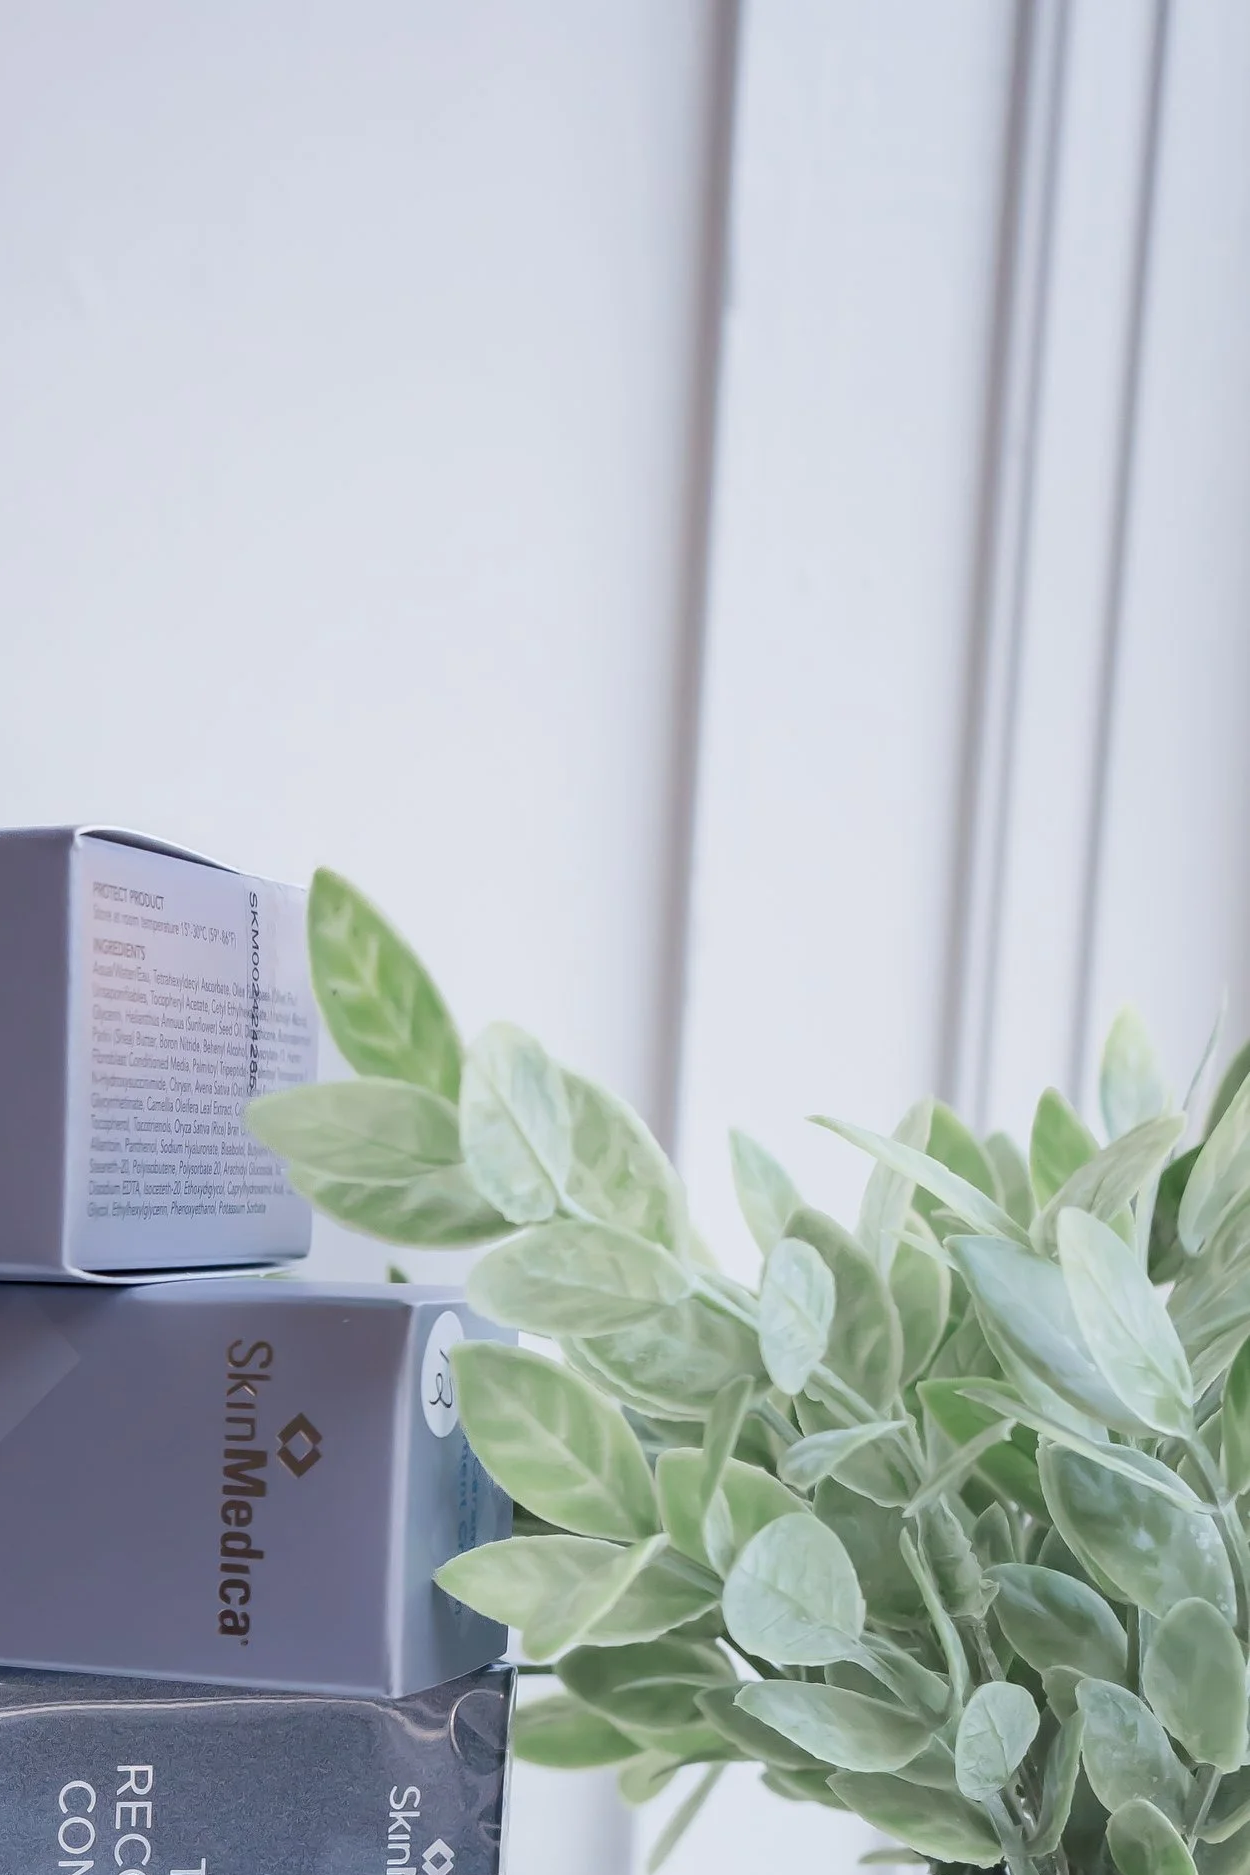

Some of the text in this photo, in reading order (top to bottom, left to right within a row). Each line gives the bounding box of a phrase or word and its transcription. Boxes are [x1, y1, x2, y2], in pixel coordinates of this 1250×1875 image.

[93, 881, 165, 910] PROTECT PRODUCT
[141, 916, 179, 936] temperature
[93, 938, 146, 961] INGREDIENTS
[218, 1020, 233, 1037] Seed
[159, 1032, 179, 1050] Boron
[194, 1078, 212, 1095] Avena
[200, 1099, 212, 1115] Leaf
[174, 1118, 192, 1138] Oryza
[193, 1119, 210, 1136] Sativa
[160, 1138, 182, 1154] Sodium
[179, 1160, 213, 1180] Polysorbate
